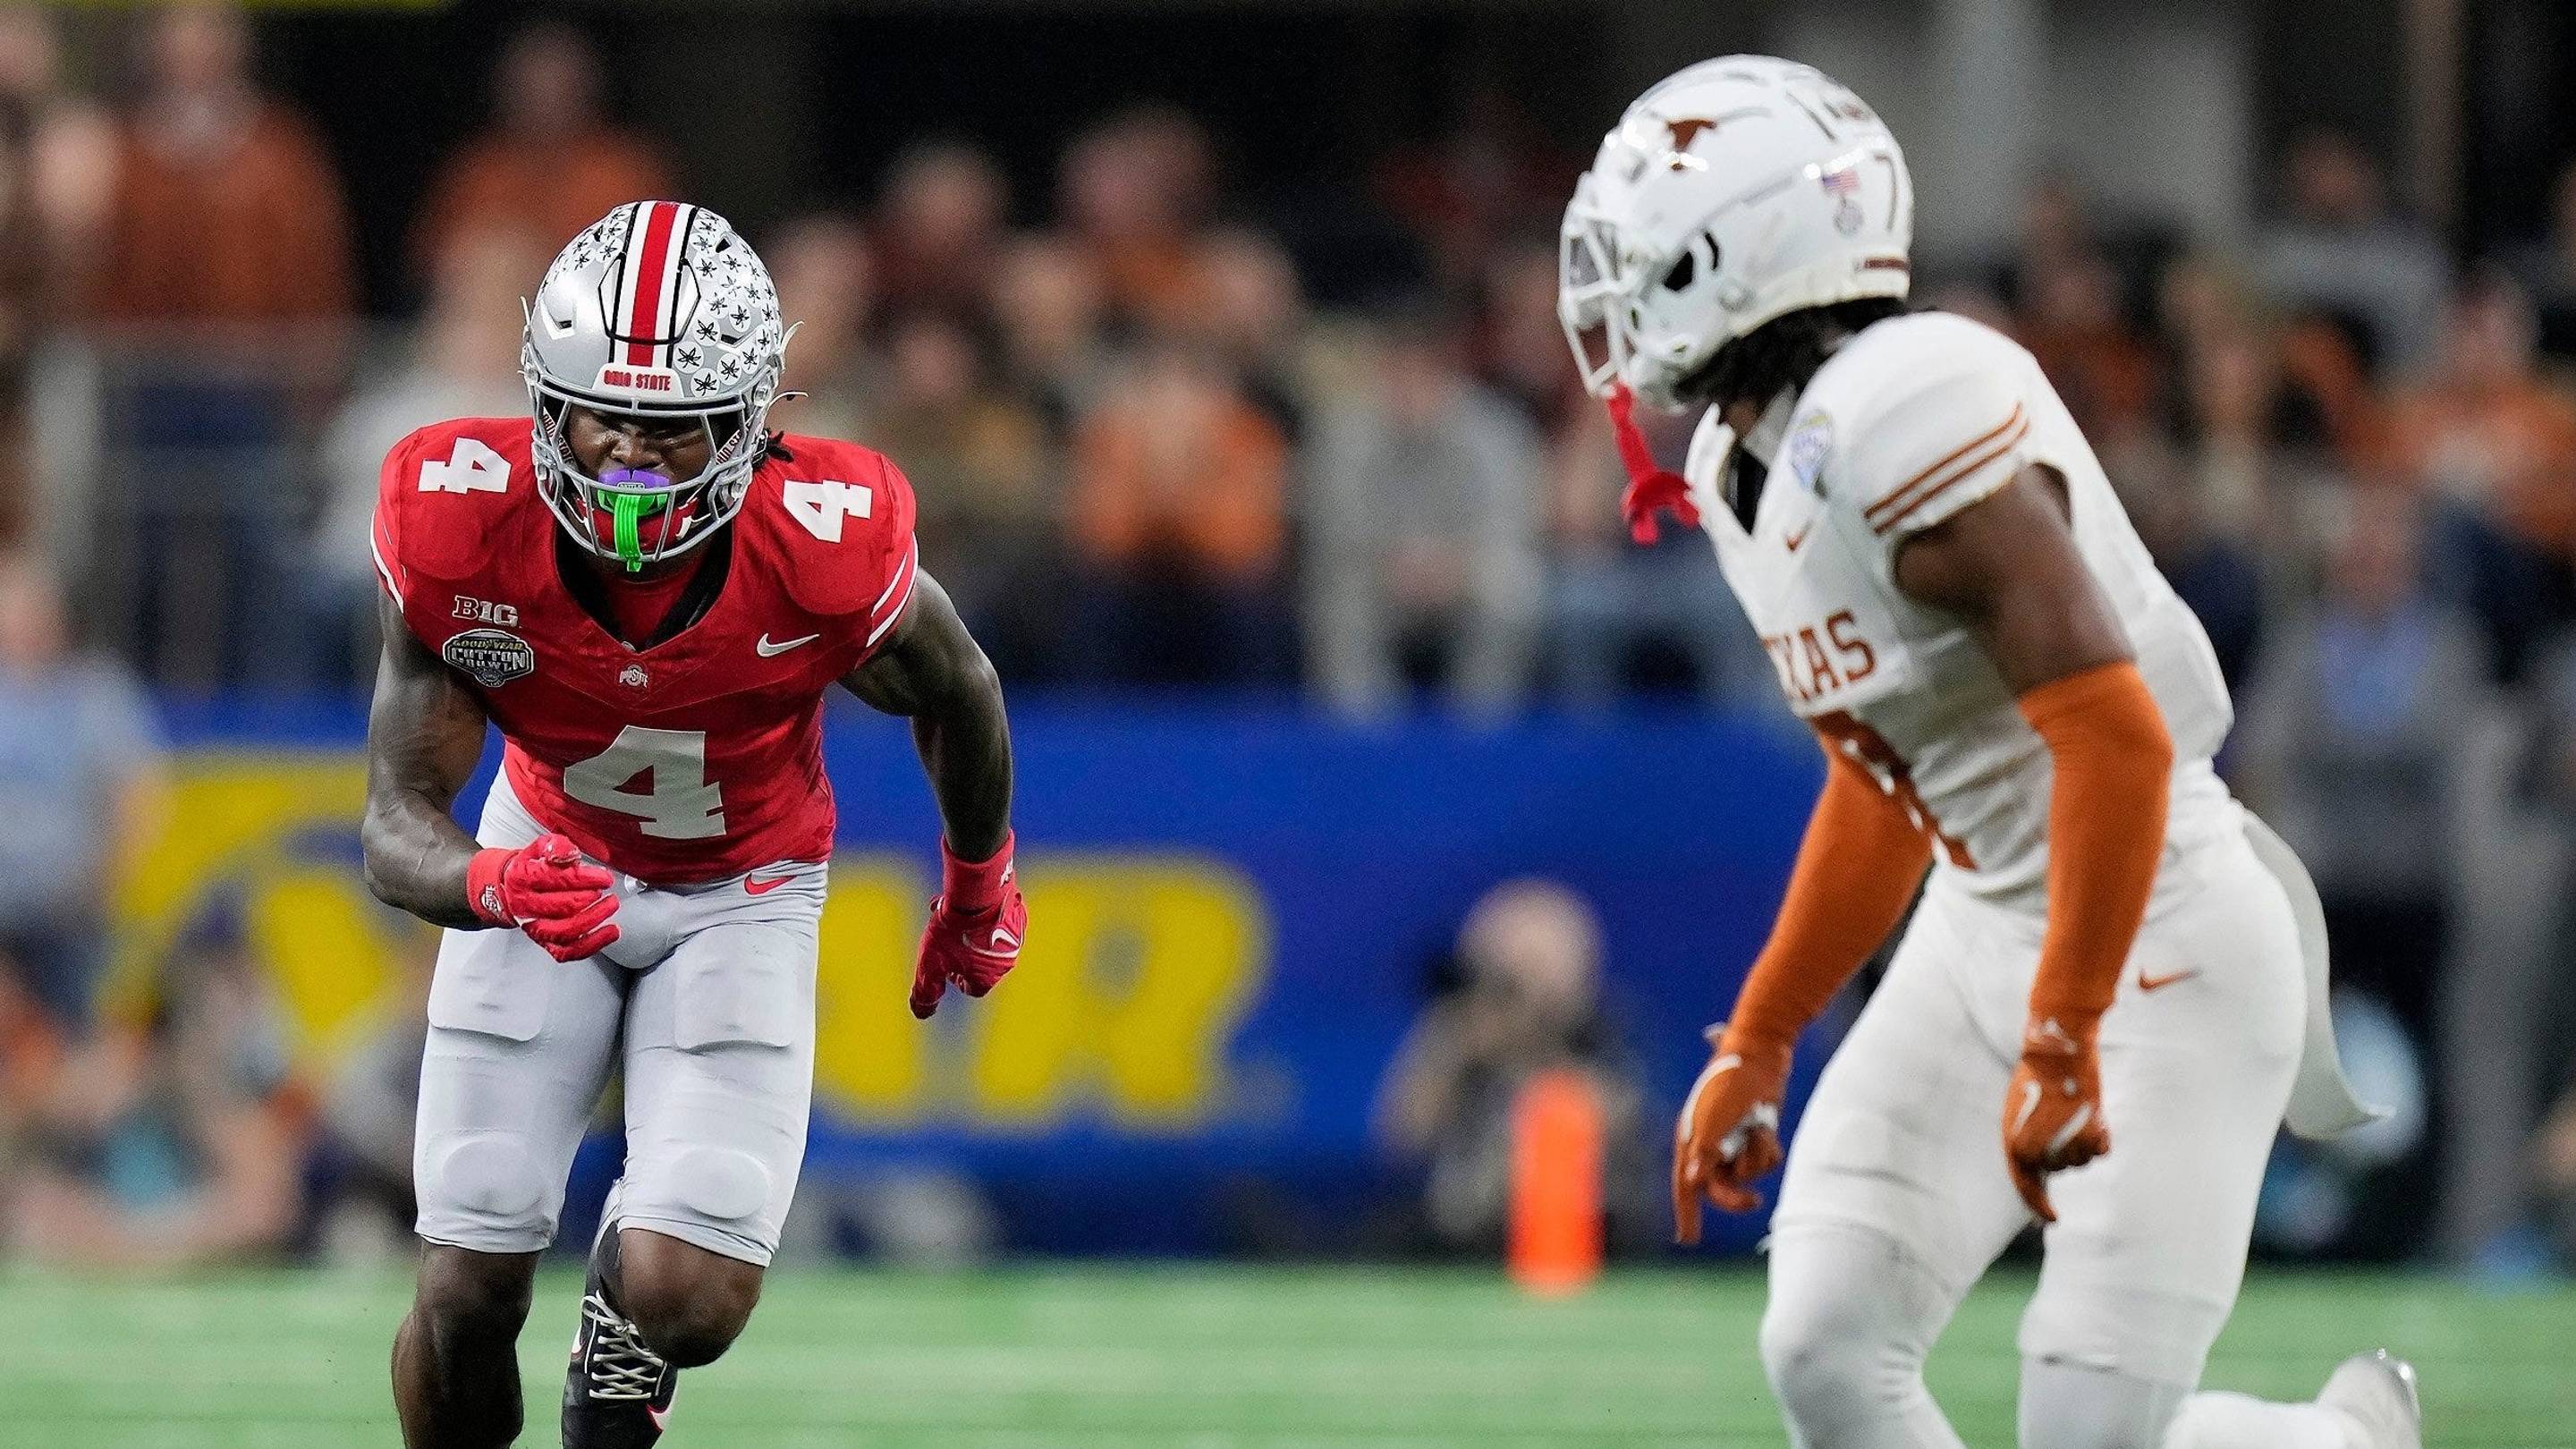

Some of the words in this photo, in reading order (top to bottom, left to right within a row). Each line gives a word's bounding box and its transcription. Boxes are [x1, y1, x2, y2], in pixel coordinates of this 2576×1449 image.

[604, 369, 632, 387] OHIO
[636, 374, 671, 391] STATE
[418, 436, 512, 495] 4
[783, 479, 873, 543] 4
[564, 725, 726, 840] 4
